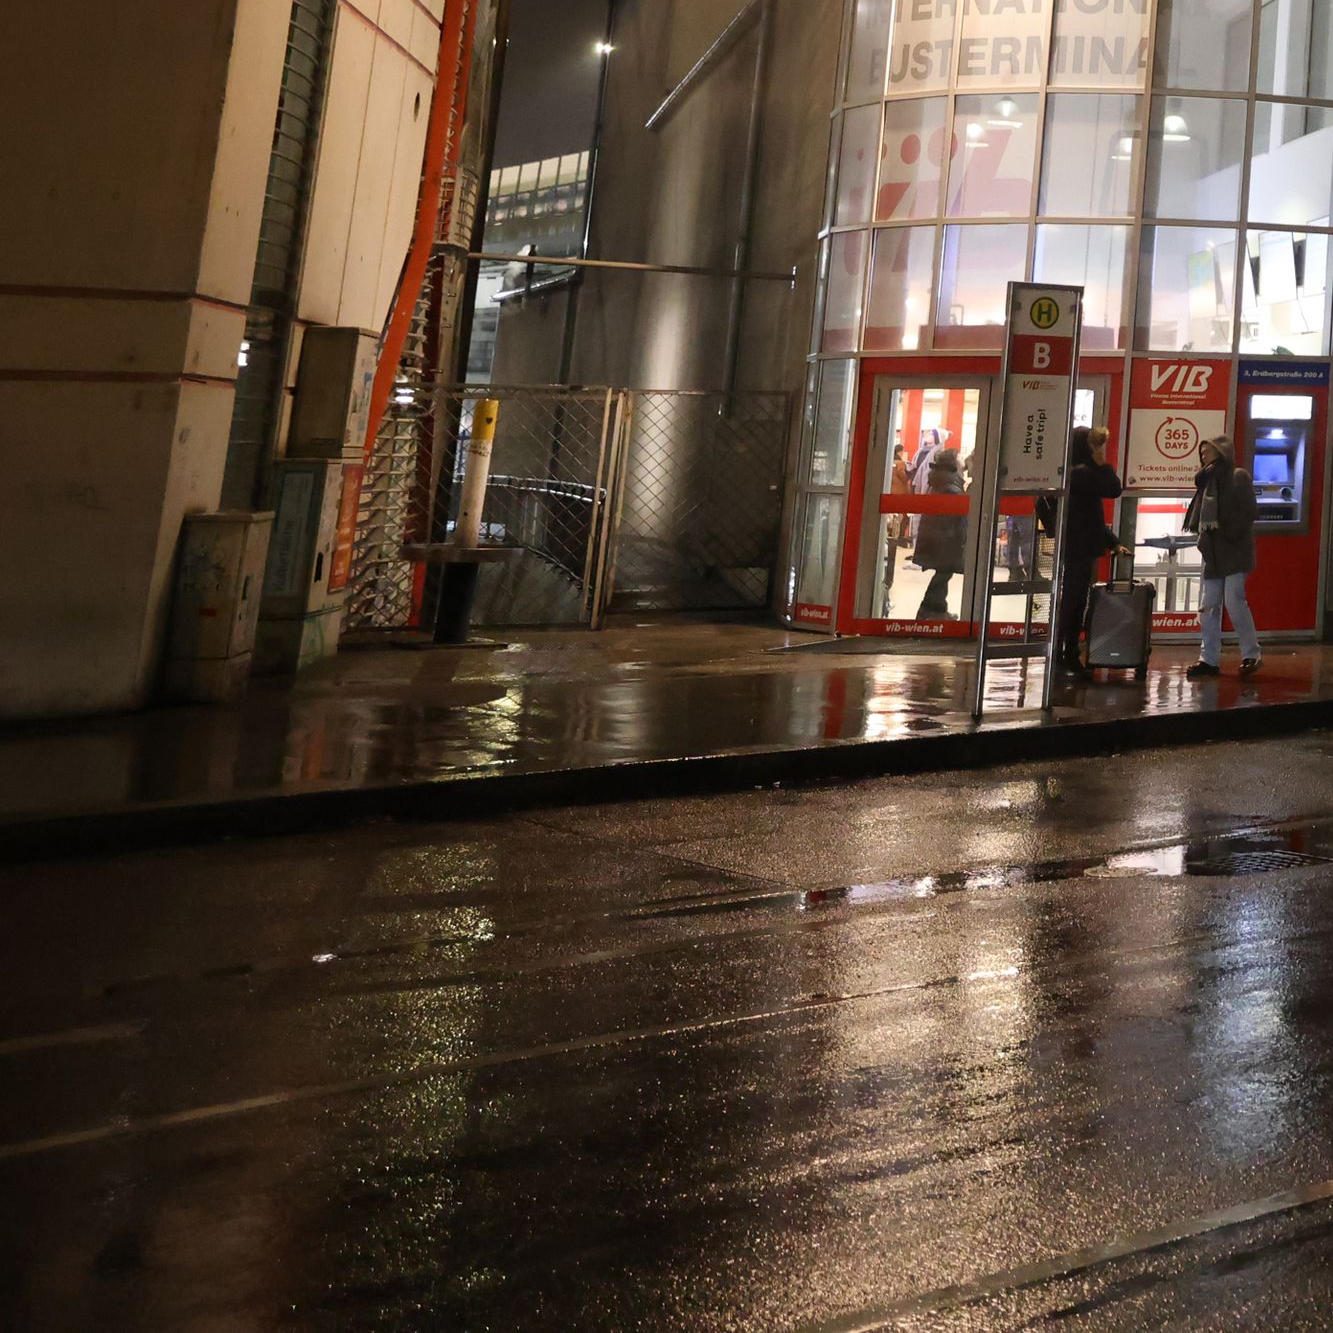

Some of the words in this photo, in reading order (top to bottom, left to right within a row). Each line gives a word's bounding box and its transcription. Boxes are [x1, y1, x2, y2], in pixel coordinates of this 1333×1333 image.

[1037, 303, 1052, 322] H
[1034, 342, 1050, 369] B
[1151, 365, 1213, 393] VIB
[1037, 409, 1047, 433] trip!
[1023, 425, 1033, 453] Have
[1165, 429, 1189, 440] 365
[885, 623, 944, 634] vib-wien.at
